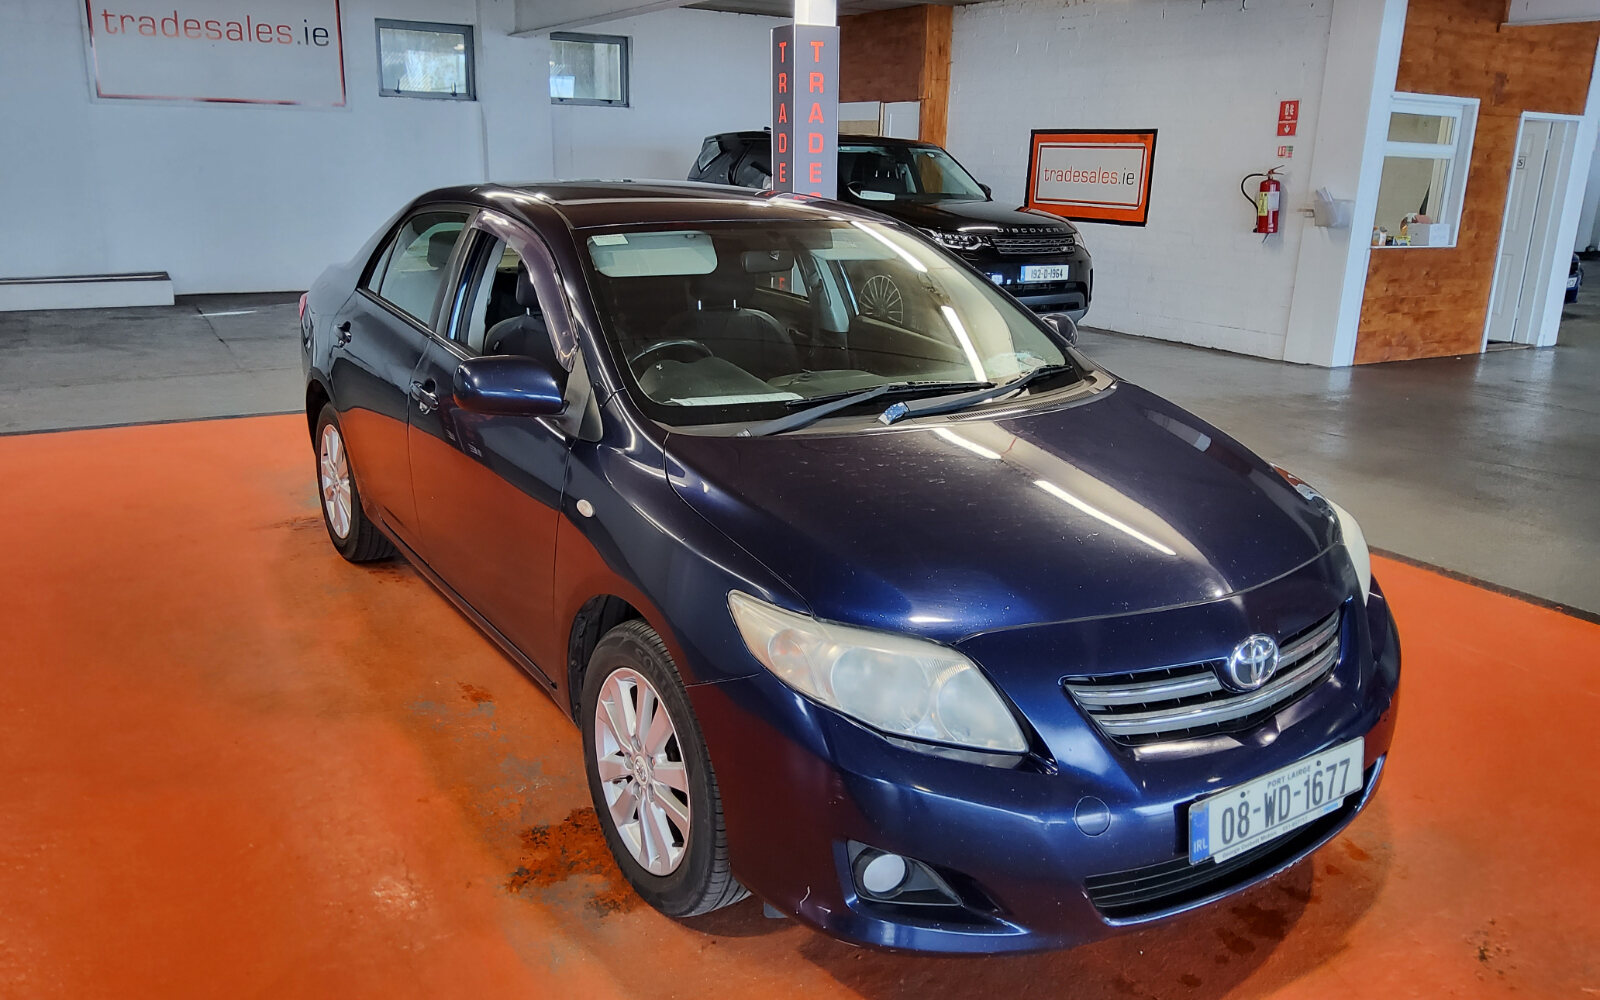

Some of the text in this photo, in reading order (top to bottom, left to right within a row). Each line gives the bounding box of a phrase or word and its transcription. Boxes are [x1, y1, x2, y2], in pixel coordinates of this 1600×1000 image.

[101, 9, 329, 47] tradesales.ie
[778, 41, 787, 183] TRADE
[808, 40, 825, 198] TRADE
[1044, 165, 1135, 186] tradesales.ie
[1267, 765, 1311, 788] PORT LAIRGE
[1221, 758, 1351, 845] 08-WD-1677
[1193, 838, 1208, 854] IRL
